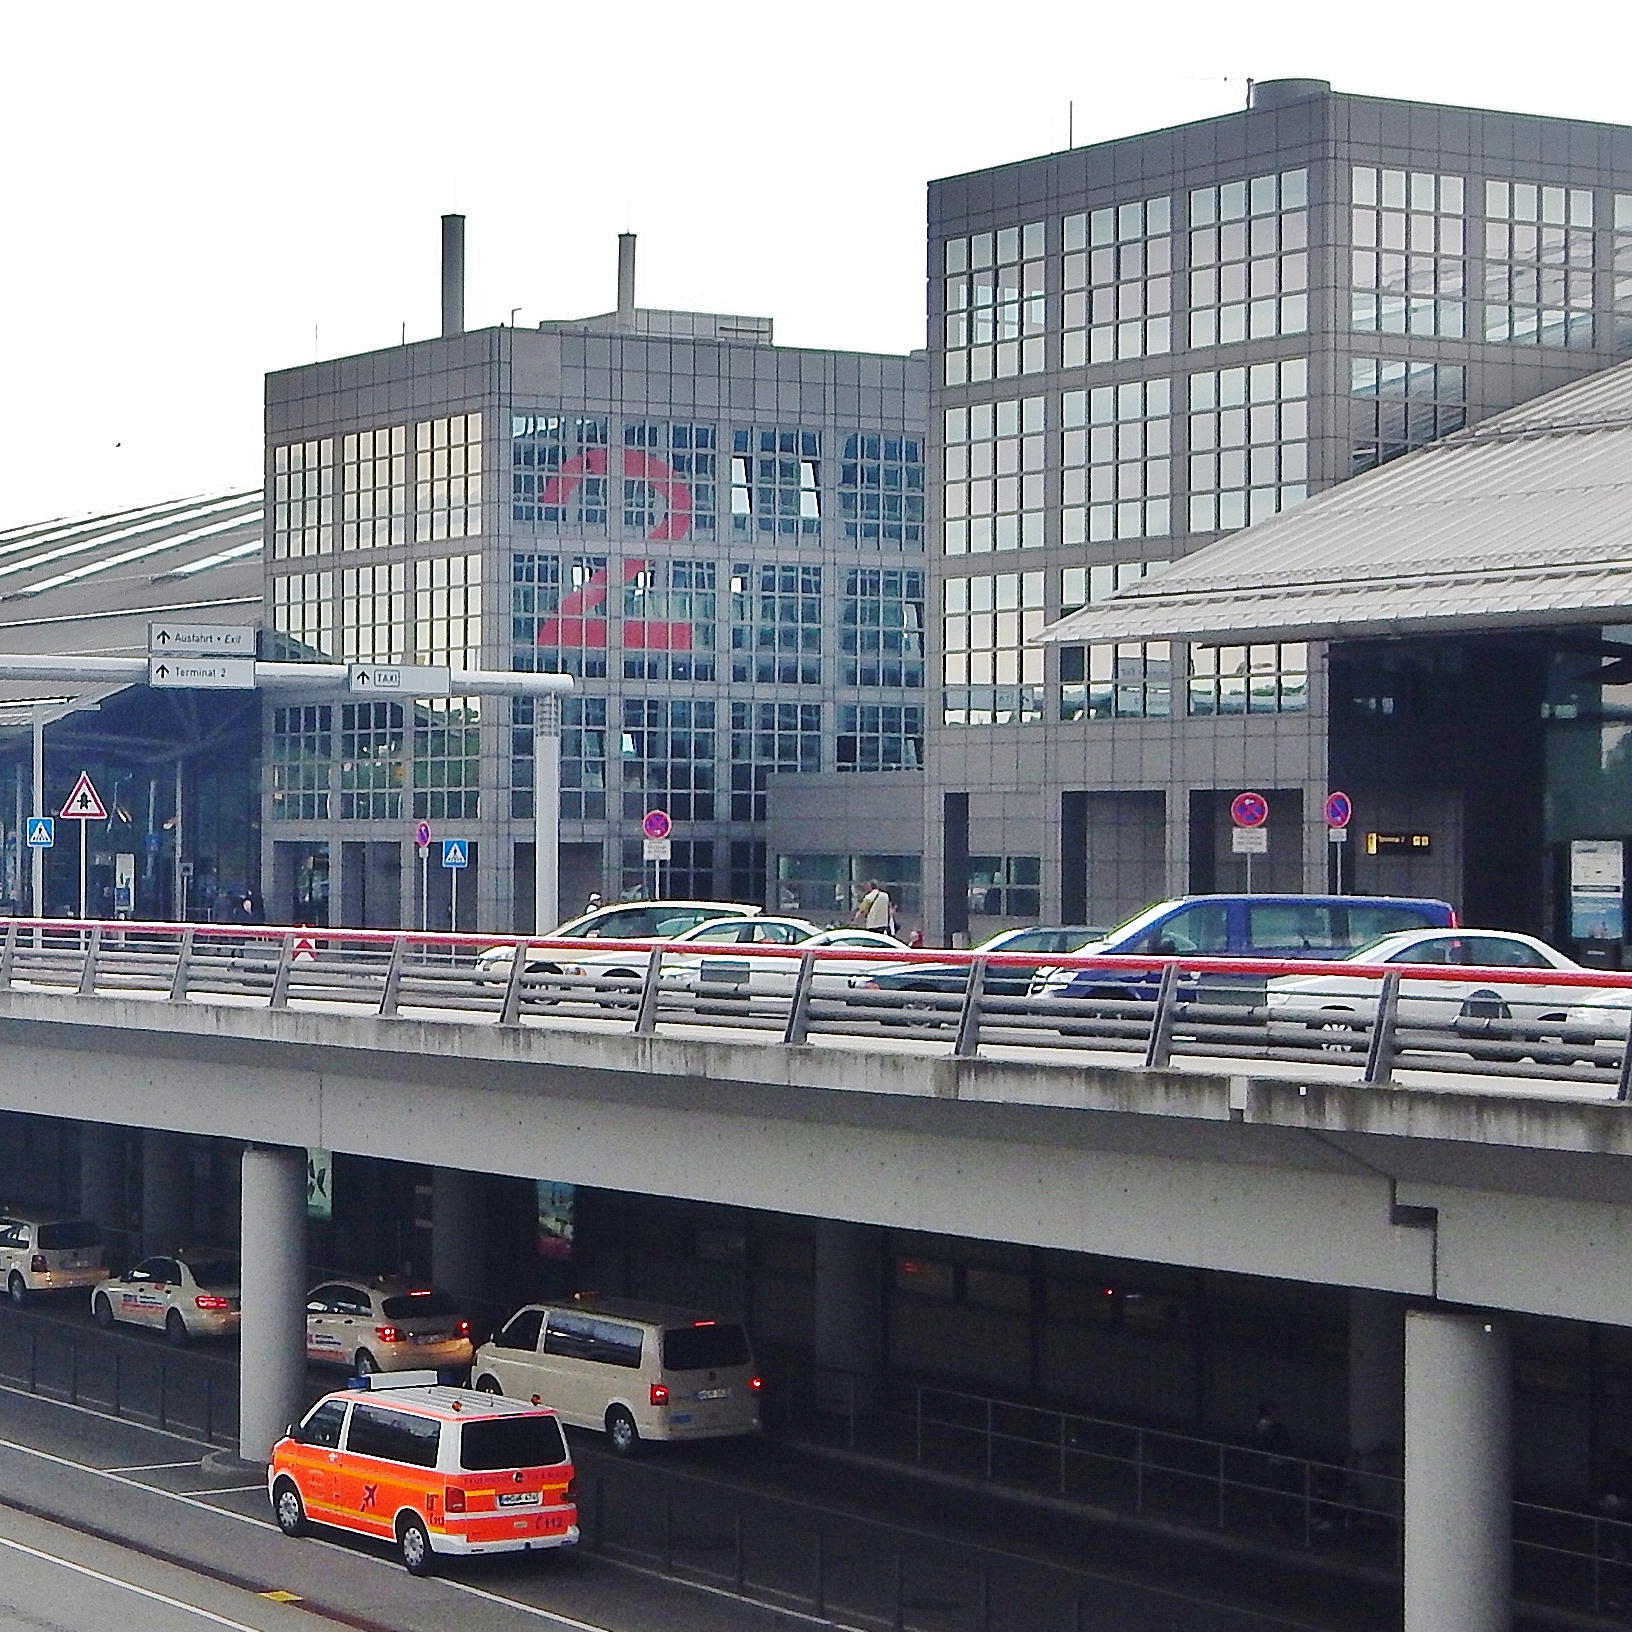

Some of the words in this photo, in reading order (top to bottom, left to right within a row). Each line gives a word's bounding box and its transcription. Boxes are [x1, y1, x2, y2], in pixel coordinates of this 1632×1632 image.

[537, 447, 693, 651] 2
[175, 632, 213, 643] Ausfahrt
[224, 634, 242, 644] Exit
[175, 666, 216, 678] Terminal
[220, 668, 226, 678] 2
[377, 673, 398, 683] TAXI
